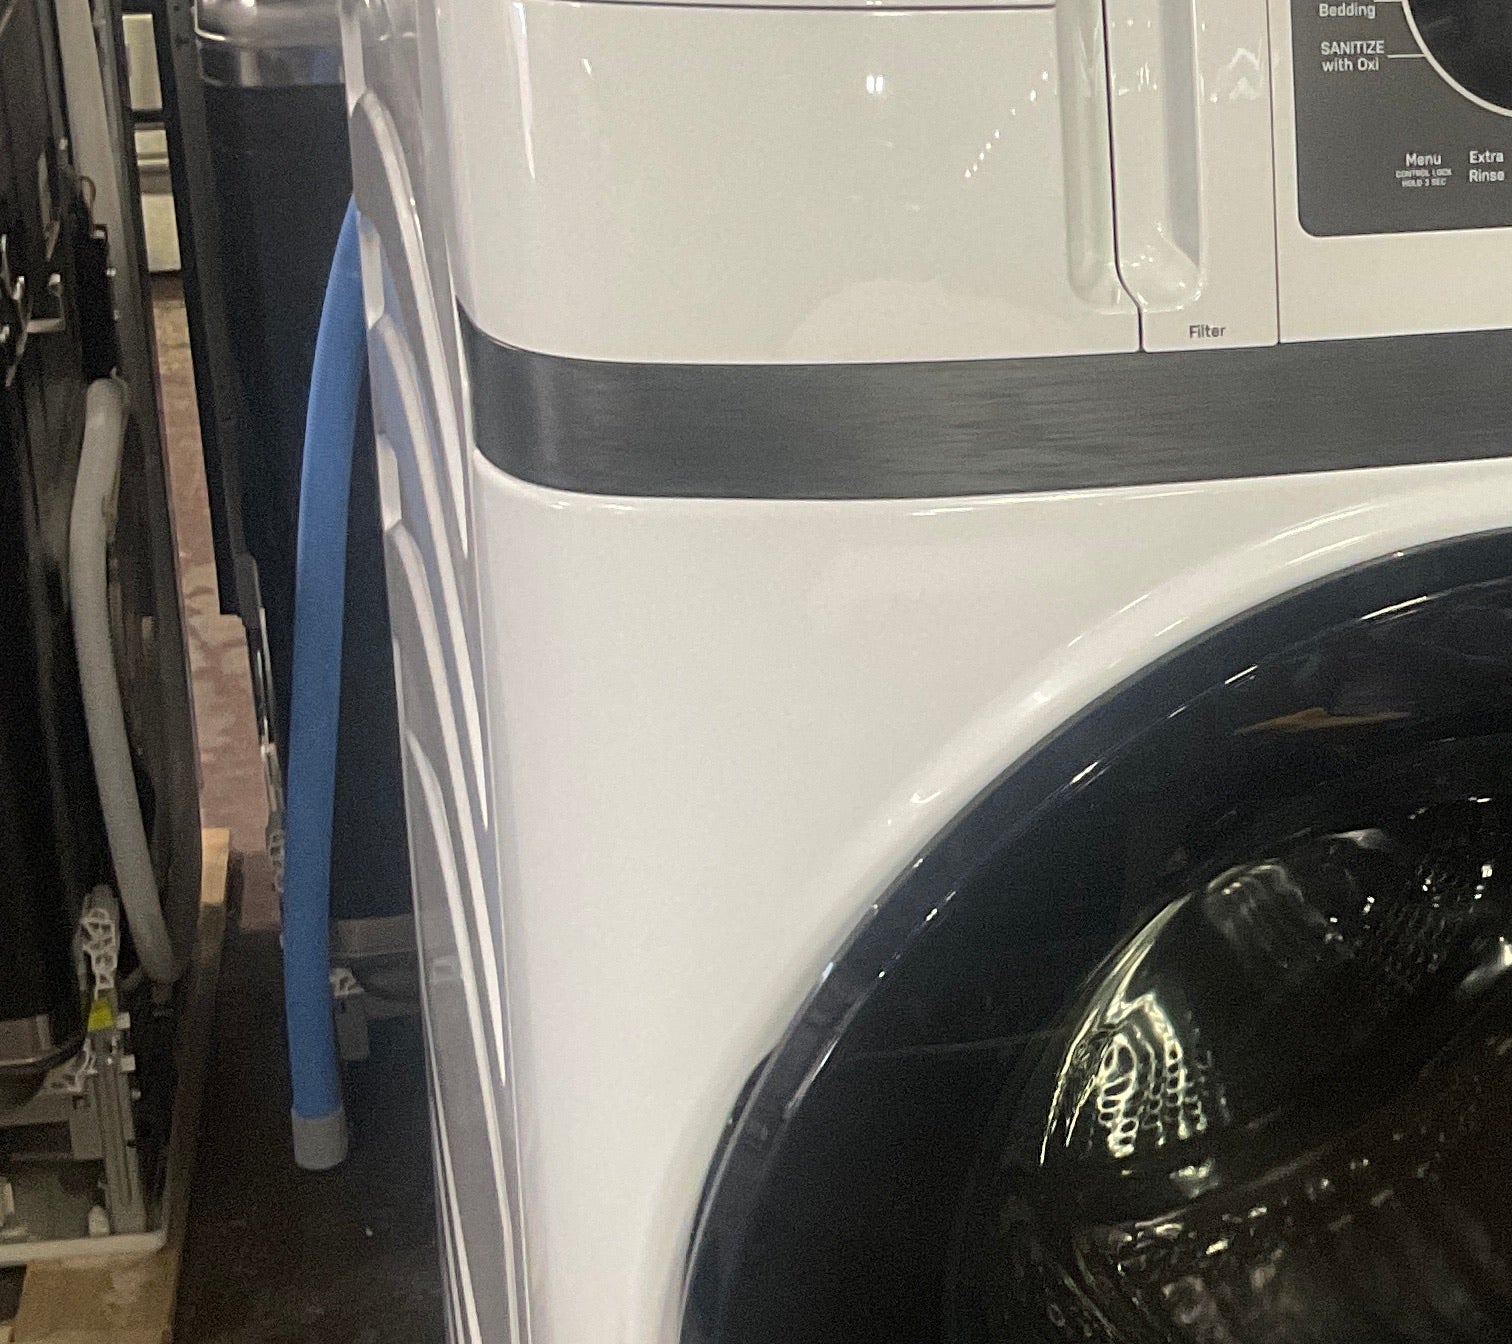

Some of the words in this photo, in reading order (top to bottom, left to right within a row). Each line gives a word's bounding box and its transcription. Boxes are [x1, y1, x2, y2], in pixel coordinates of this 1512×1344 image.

[1319, 2, 1376, 20] Bedding
[1320, 40, 1385, 56] SANITIZE
[1321, 57, 1354, 72] with
[1357, 56, 1380, 72] Oxi
[1405, 152, 1442, 167] Menu
[1469, 150, 1505, 164] Extra
[1469, 168, 1506, 183] Rinse
[1188, 324, 1227, 339] Filter
